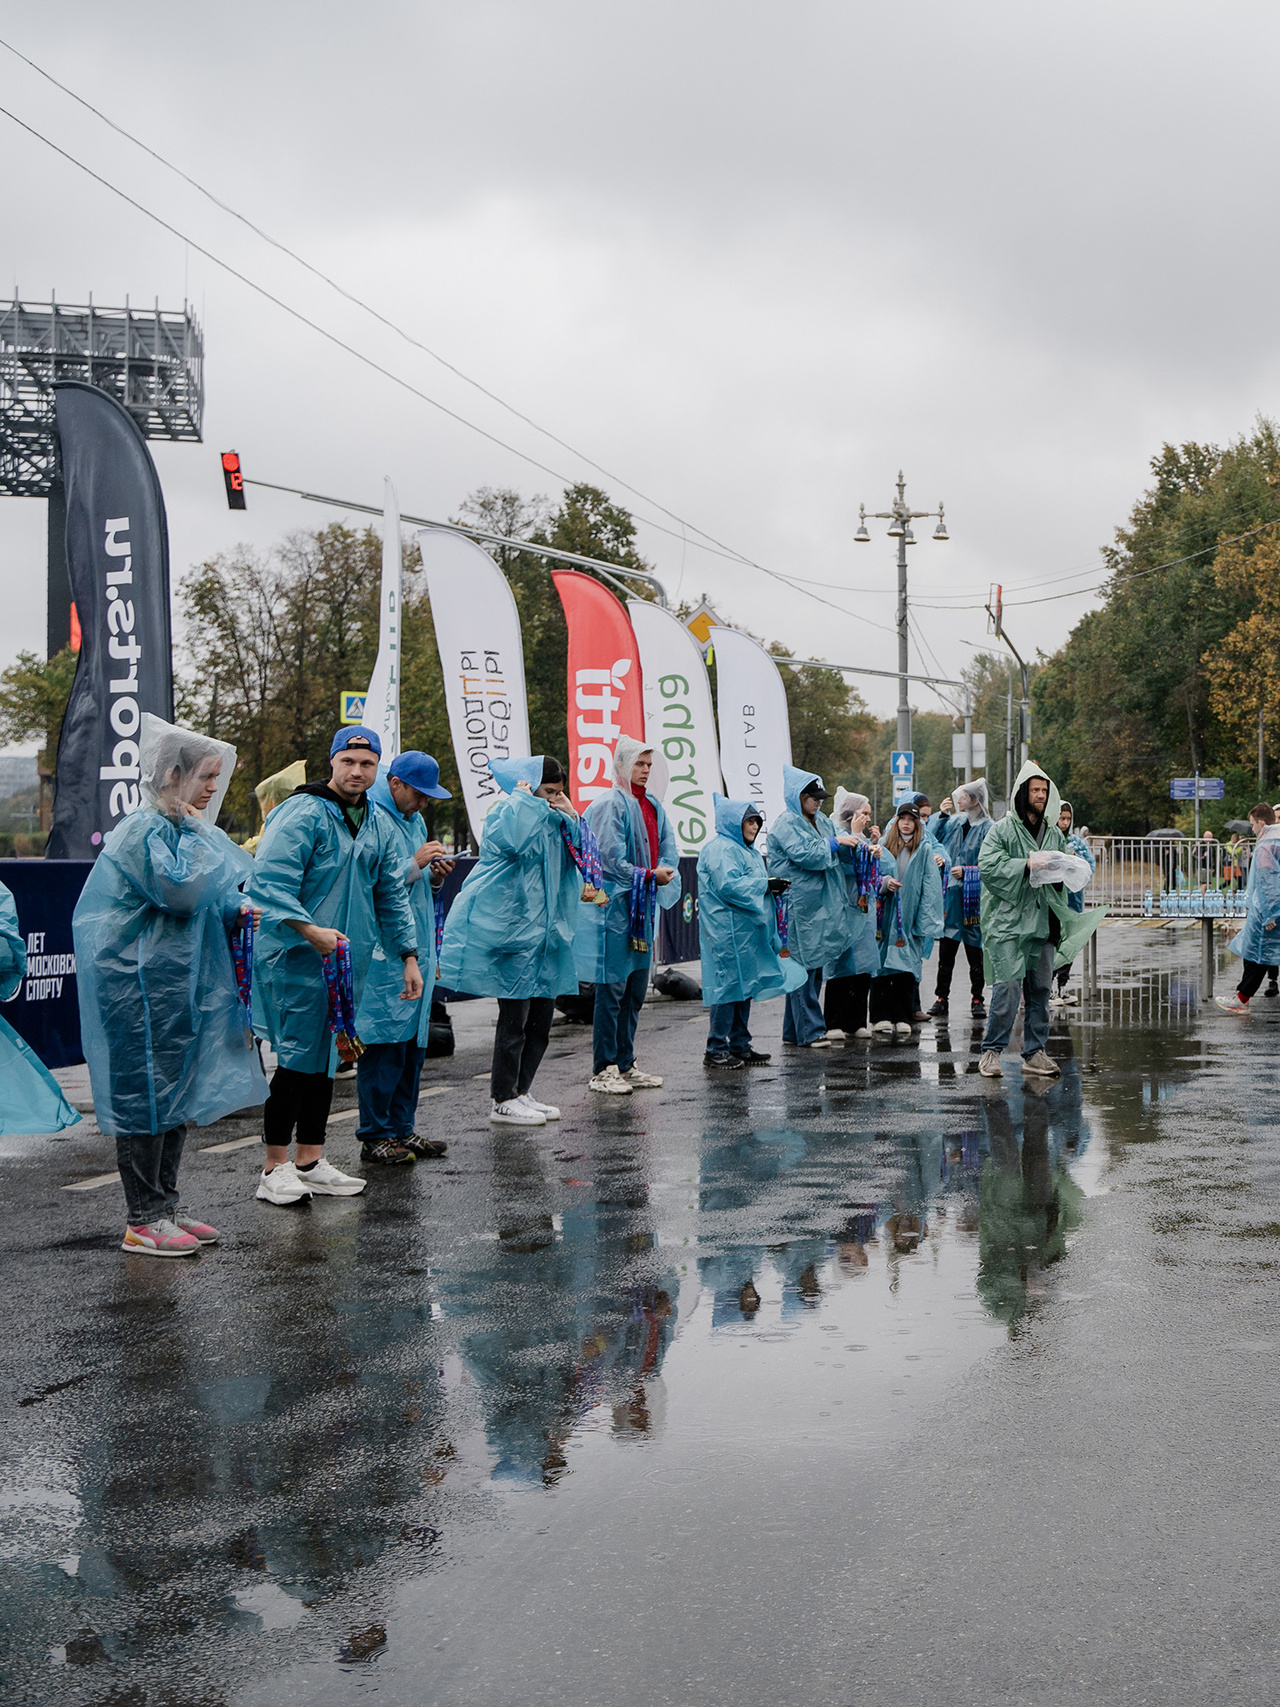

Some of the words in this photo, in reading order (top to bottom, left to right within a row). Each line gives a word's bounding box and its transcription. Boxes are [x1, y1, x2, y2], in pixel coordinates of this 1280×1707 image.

[230, 472, 243, 491] 12
[27, 932, 46, 953] ЛЕТ
[26, 954, 77, 977] МОСКОВСК
[26, 977, 63, 1001] СПОРТУ
